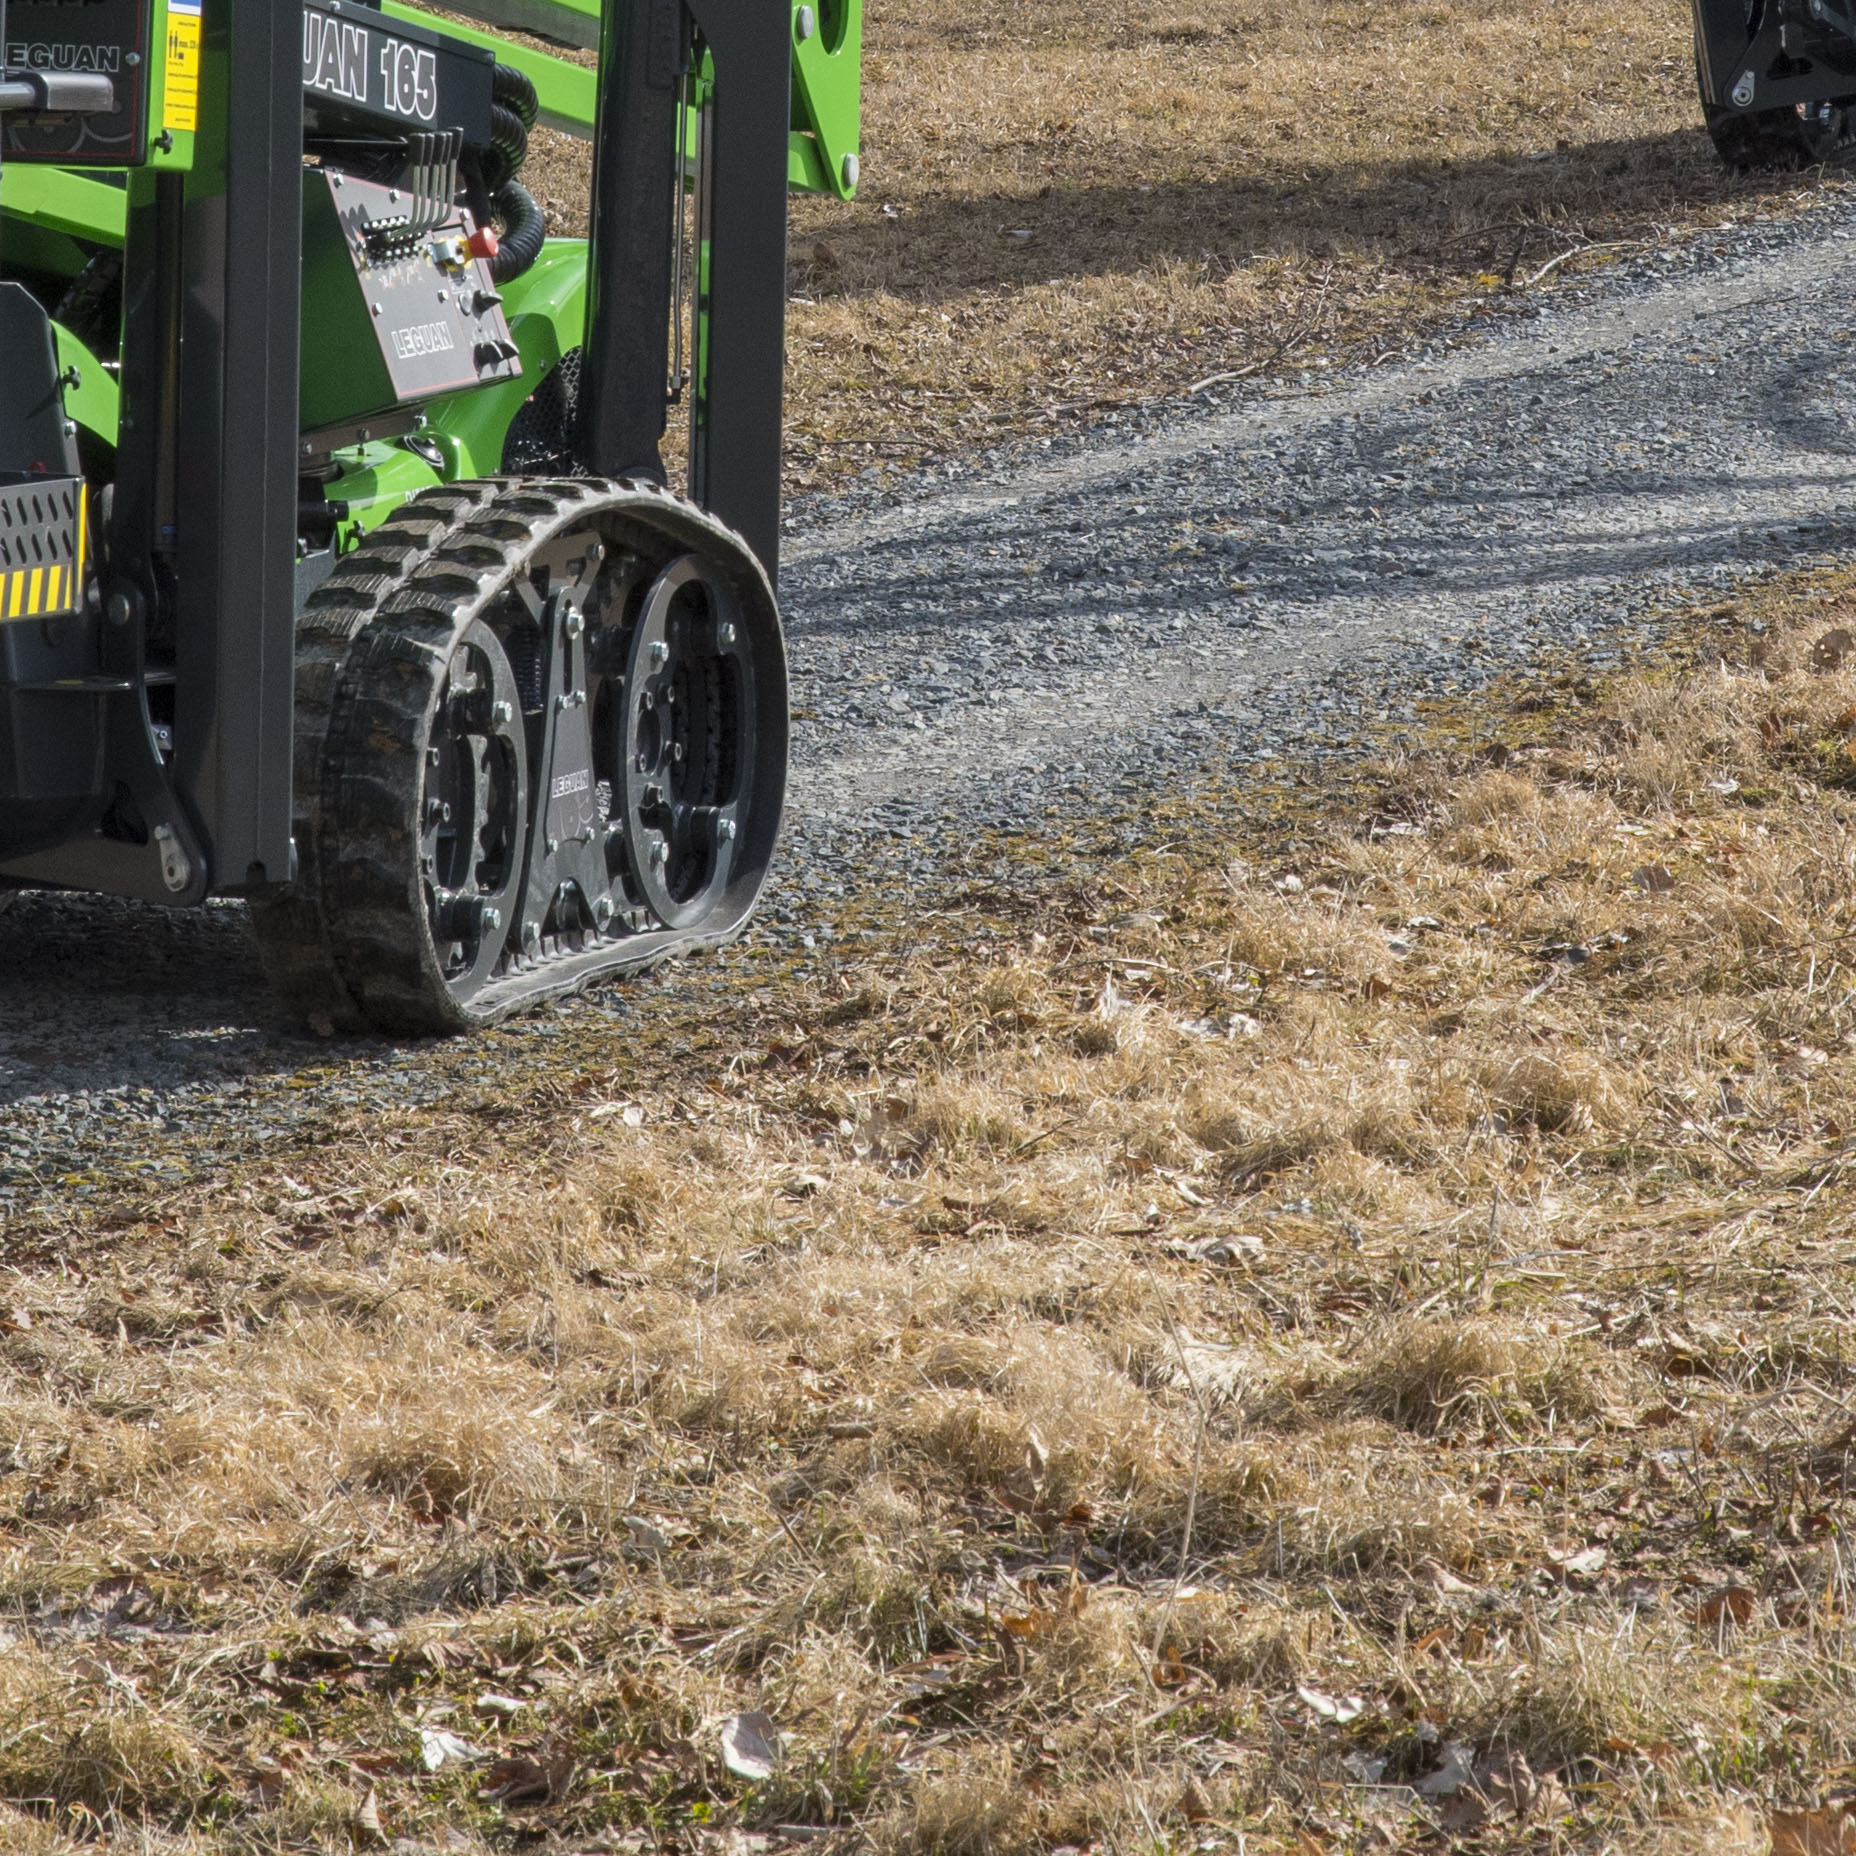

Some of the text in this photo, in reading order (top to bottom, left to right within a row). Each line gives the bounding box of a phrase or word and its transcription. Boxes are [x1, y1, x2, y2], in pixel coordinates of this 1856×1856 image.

[6, 42, 120, 72] EGUAN
[302, 10, 368, 102] UAN
[380, 38, 437, 121] 165
[392, 321, 454, 359] LEGUAN
[551, 768, 589, 799] LEGUAN
